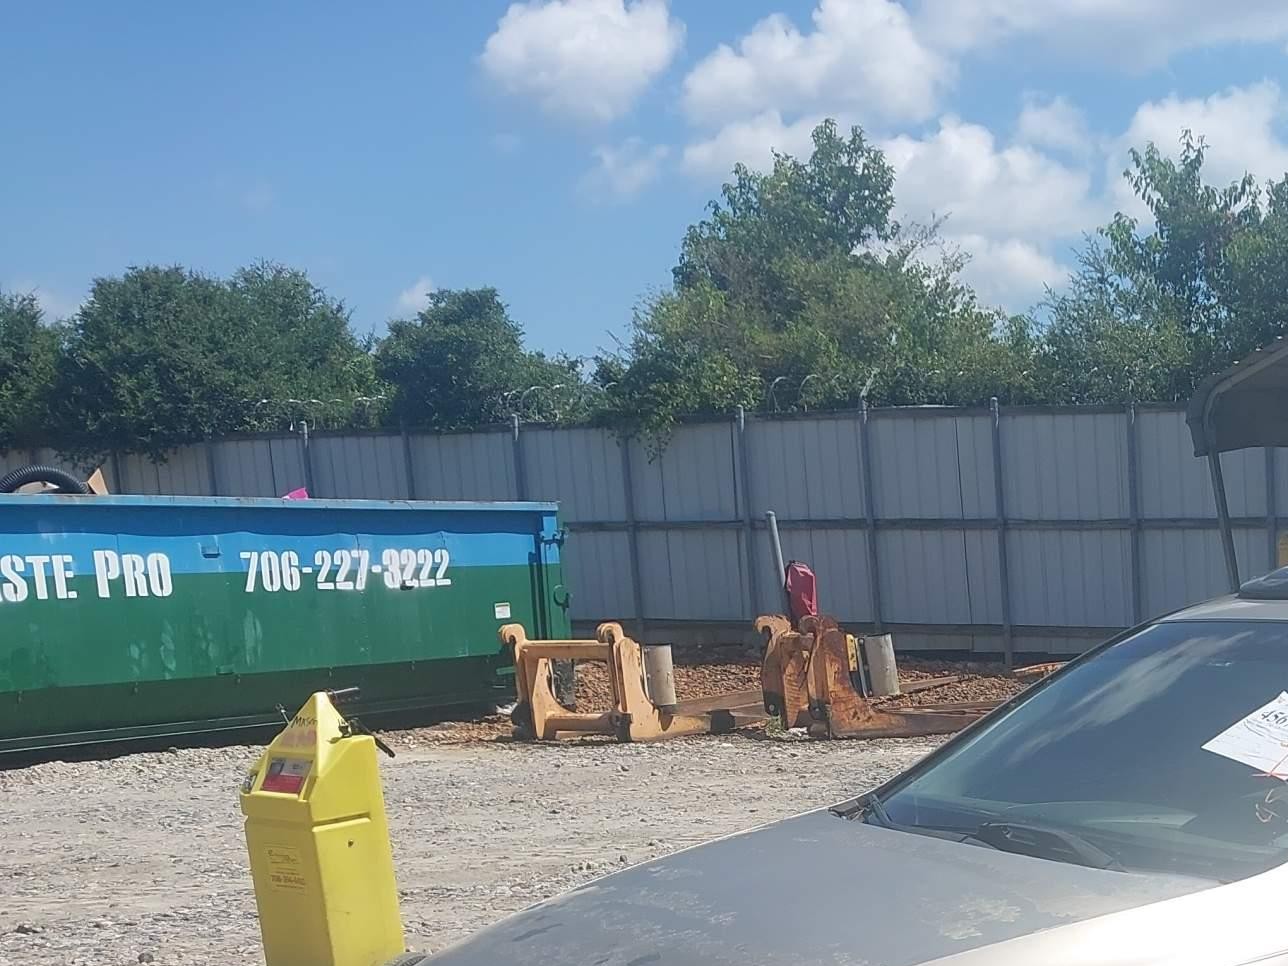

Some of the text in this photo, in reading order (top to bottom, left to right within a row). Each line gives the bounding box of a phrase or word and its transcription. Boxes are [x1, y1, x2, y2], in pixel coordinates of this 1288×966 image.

[0, 549, 452, 602] STE PRO 706-227-3222
